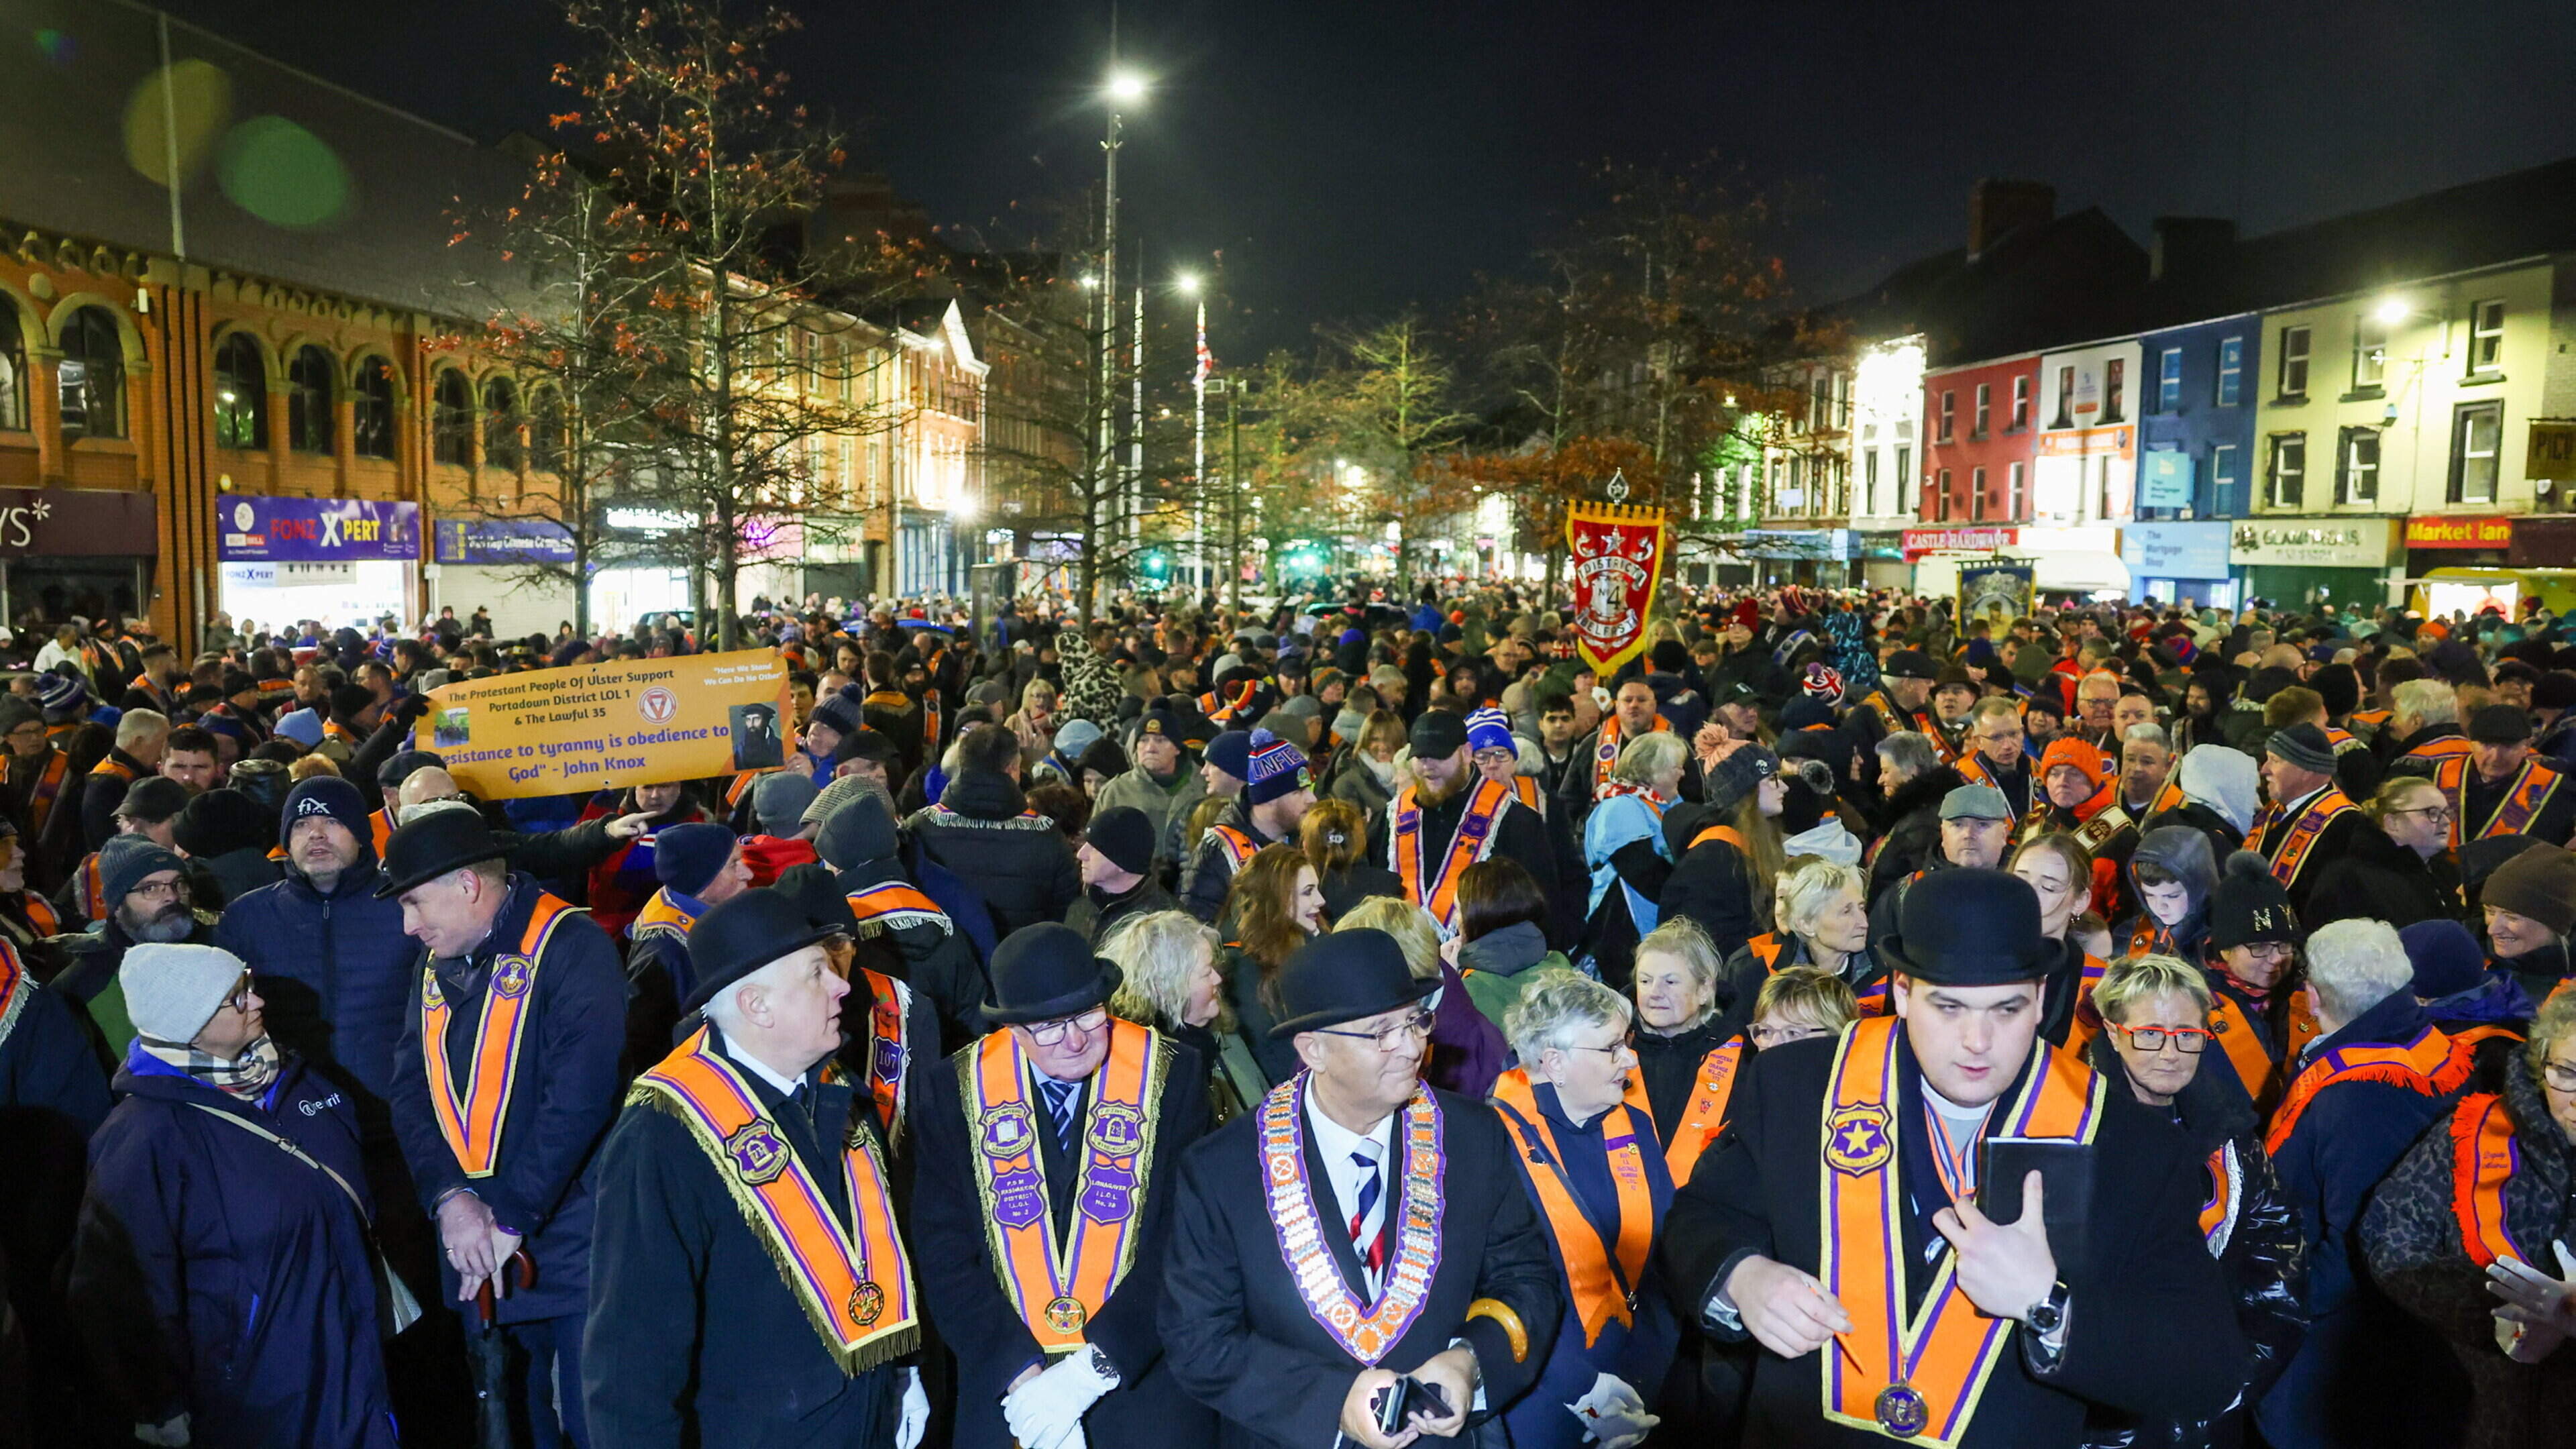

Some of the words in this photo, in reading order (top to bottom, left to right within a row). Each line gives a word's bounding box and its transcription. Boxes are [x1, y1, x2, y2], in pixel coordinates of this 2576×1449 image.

[1911, 534, 1946, 548] CASTLE
[2407, 523, 2472, 541] Market
[2478, 523, 2512, 541] lan
[1583, 558, 1641, 576] DISTRICT
[1607, 586, 1621, 610] 4
[751, 663, 773, 671] Stand
[449, 692, 467, 702] The
[470, 684, 527, 700] Protestant
[530, 677, 567, 692] People
[570, 675, 585, 689] Of
[588, 674, 623, 686] Ulster
[627, 669, 674, 683] Support
[489, 698, 550, 712] Portadown
[553, 692, 597, 706] District
[600, 689, 621, 701] LOL
[625, 688, 631, 699] 1
[515, 716, 522, 726] &
[526, 713, 545, 724] The
[549, 709, 589, 724] Lawful
[592, 707, 606, 718] 35
[518, 745, 534, 757] to
[538, 737, 604, 758] tyranny
[608, 733, 623, 749] is
[627, 727, 708, 747] obedience
[712, 724, 729, 737] to
[508, 763, 547, 784] God"
[563, 759, 600, 778] John
[605, 755, 646, 771] Knox
[297, 798, 331, 814] fix
[879, 1050, 897, 1069] 107
[1709, 1063, 1729, 1073] ORANGE
[1004, 1192, 1033, 1202] DISTRICT
